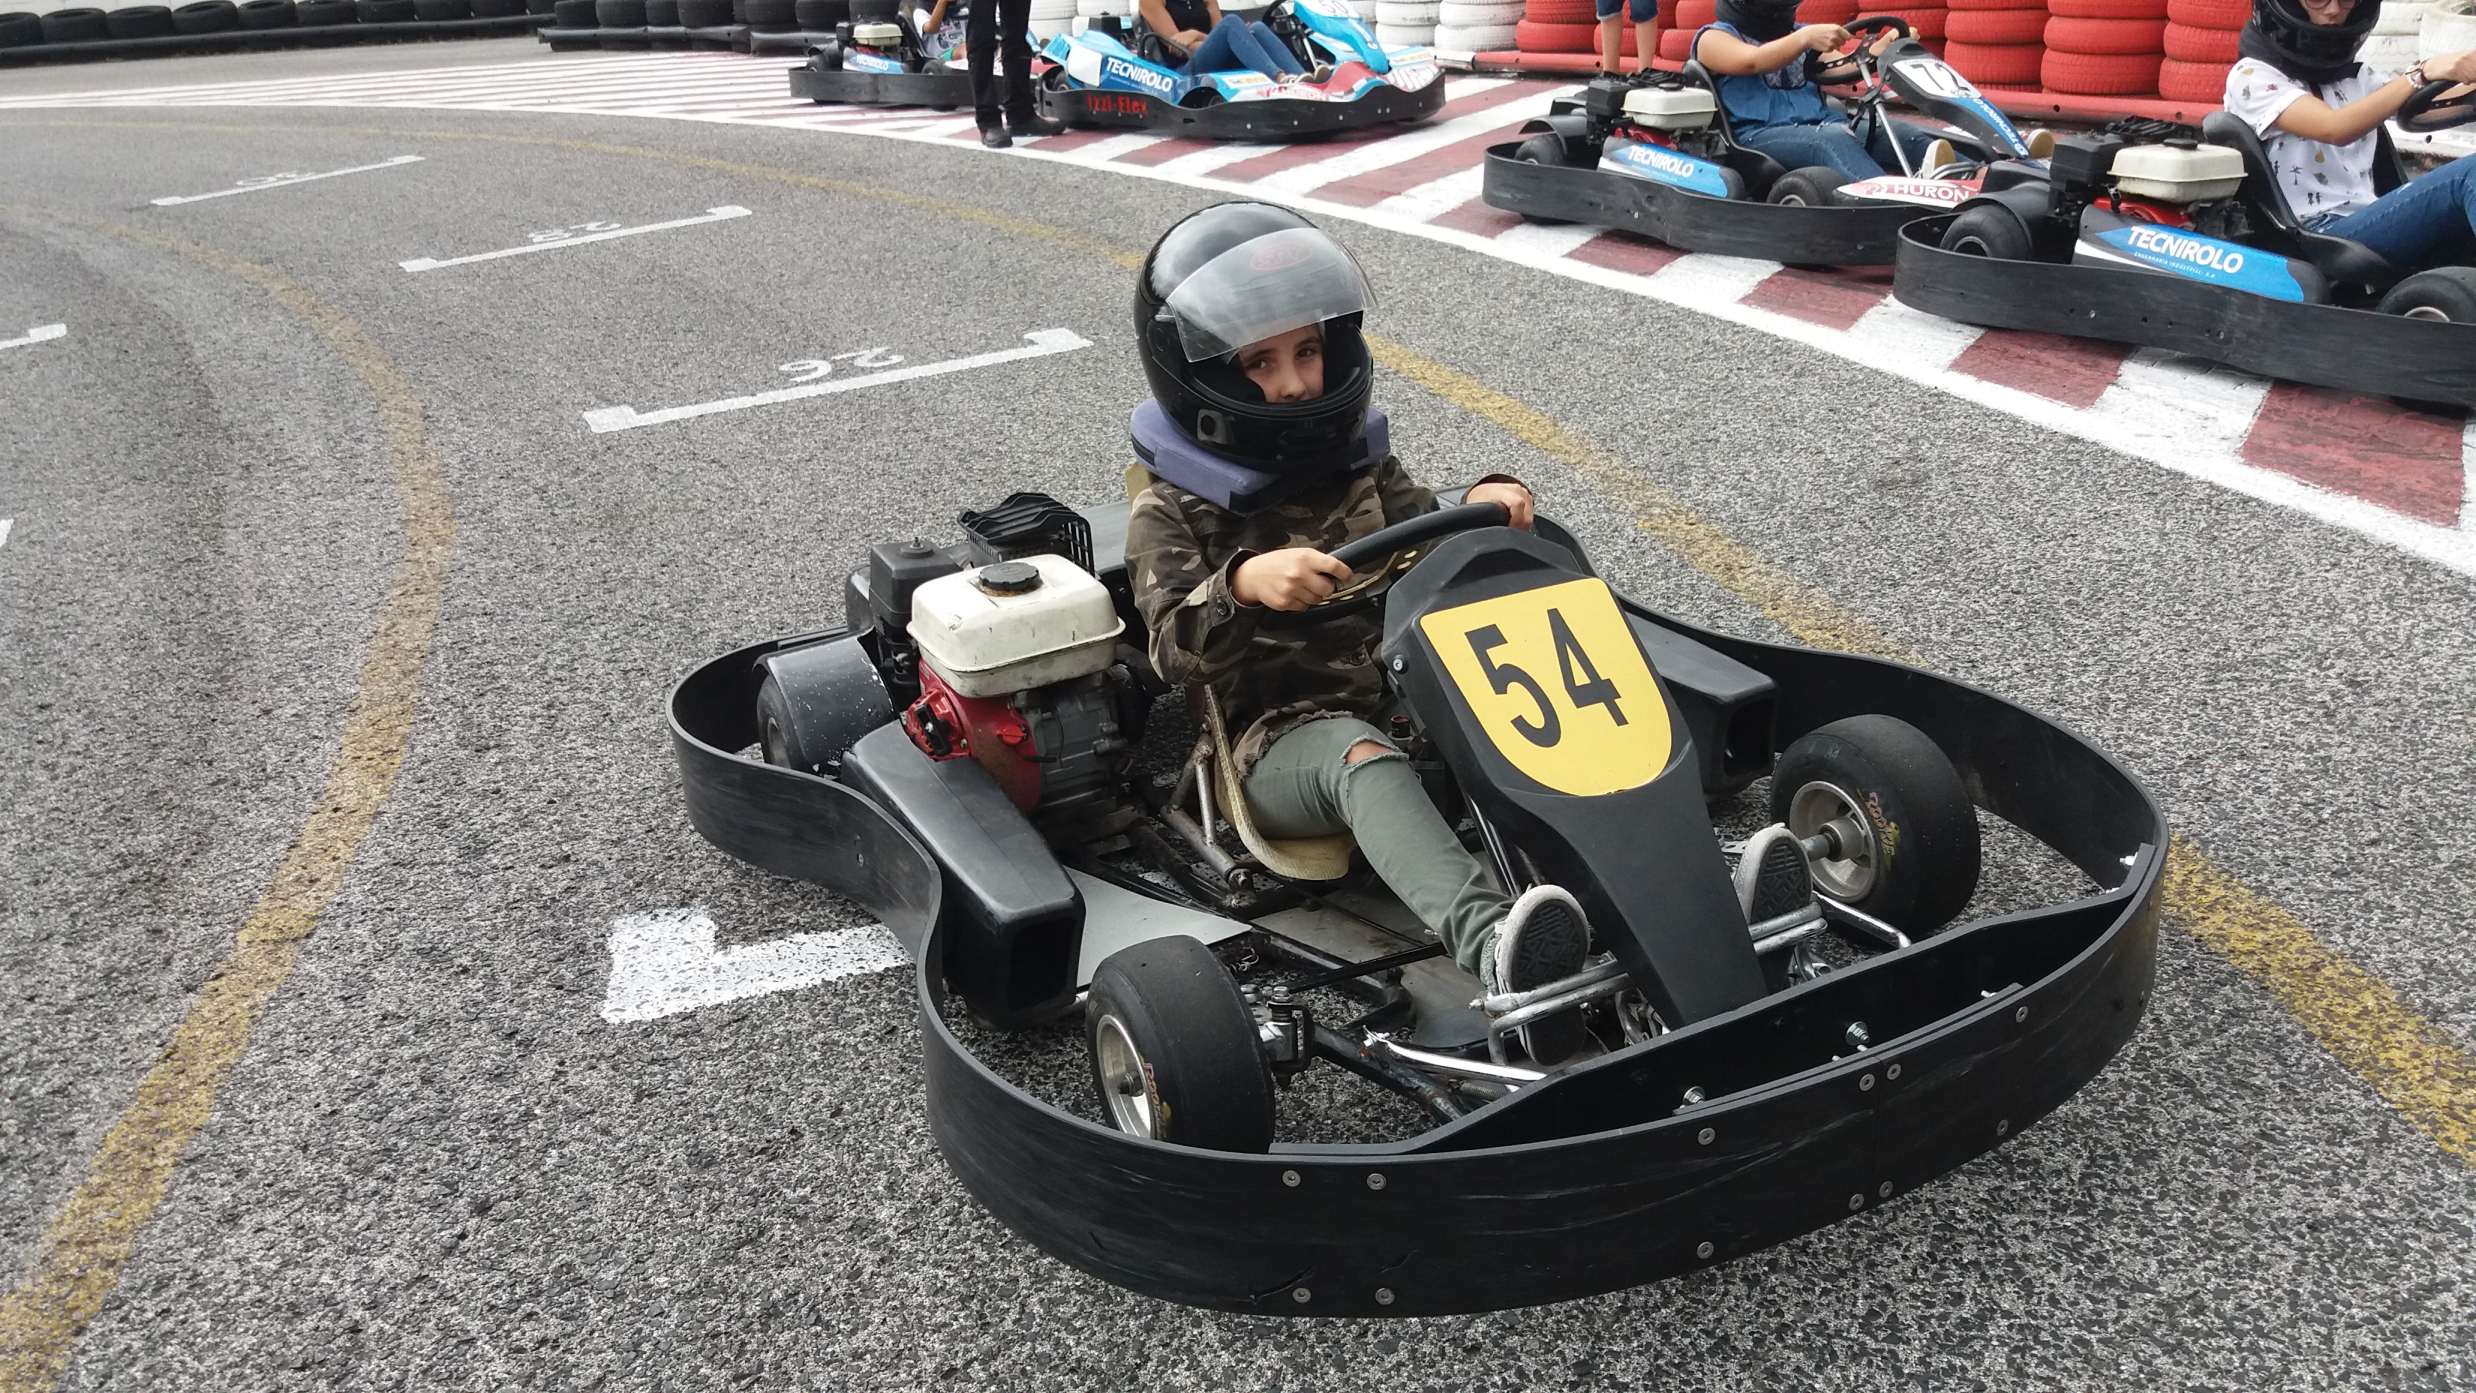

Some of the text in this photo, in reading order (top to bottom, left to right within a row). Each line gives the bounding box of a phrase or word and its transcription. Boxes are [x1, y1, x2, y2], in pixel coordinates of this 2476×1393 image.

[1106, 57, 1173, 92] TECNIROLO
[1910, 63, 1970, 91] 72
[1628, 145, 1694, 177] TECNIROLO
[1894, 184, 1969, 202] HURON
[2128, 226, 2244, 273] TECNIROLO
[1464, 608, 1629, 748] 54
